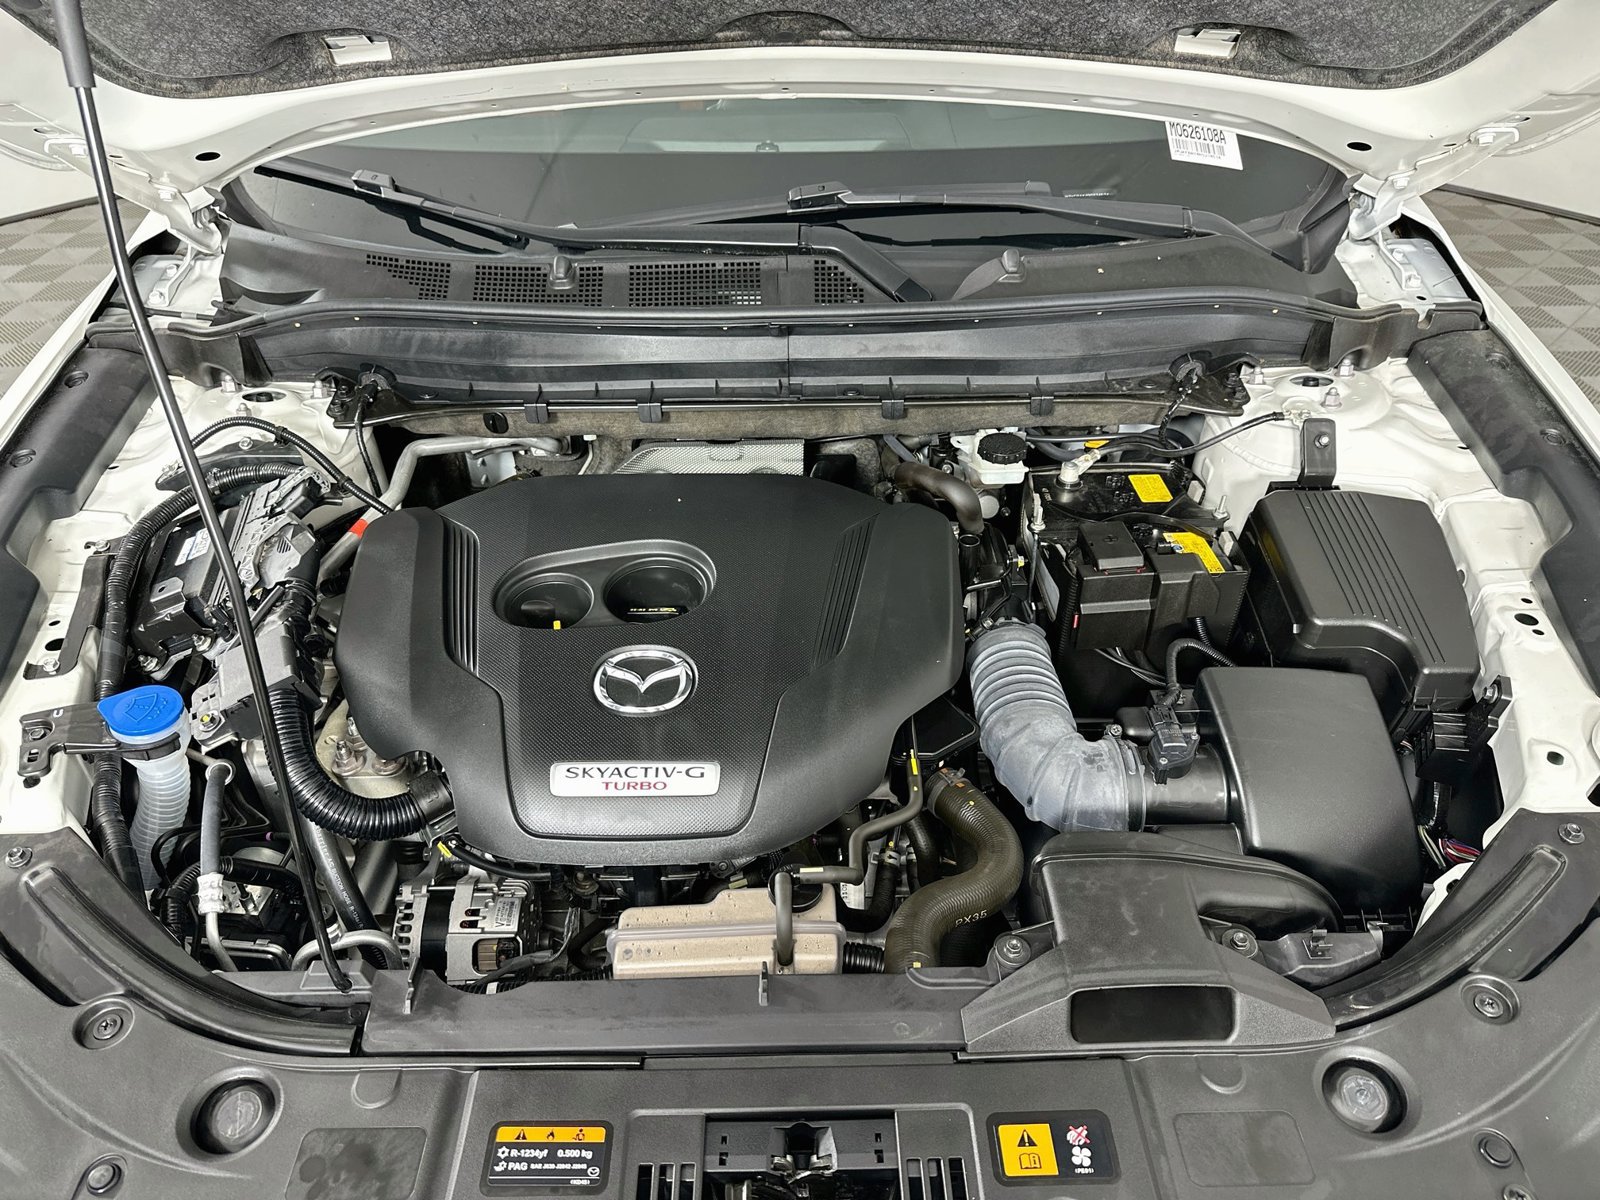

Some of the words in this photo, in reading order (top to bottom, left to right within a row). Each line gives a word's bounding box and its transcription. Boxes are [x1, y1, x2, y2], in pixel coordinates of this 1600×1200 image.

[565, 766, 705, 779] SKYACTIV-G
[602, 781, 668, 791] TURBO
[342, 891, 351, 905] HOSE
[510, 1149, 548, 1159] R-1234yf
[557, 1149, 580, 1158] 0.500
[581, 1149, 593, 1159] kg
[508, 1162, 528, 1171] PAG
